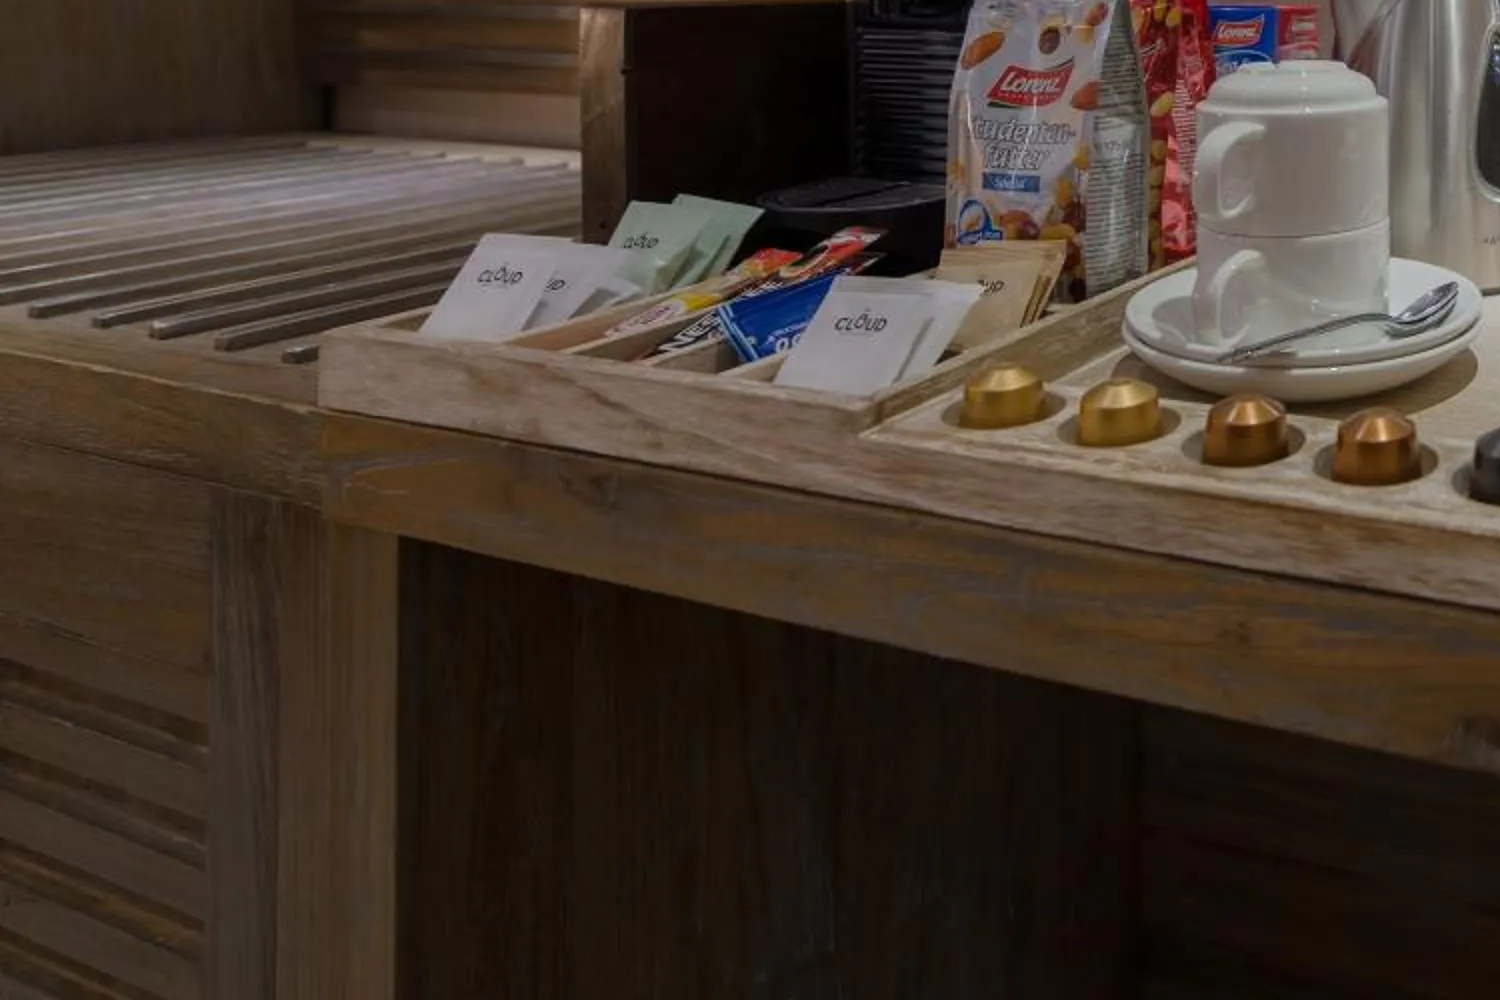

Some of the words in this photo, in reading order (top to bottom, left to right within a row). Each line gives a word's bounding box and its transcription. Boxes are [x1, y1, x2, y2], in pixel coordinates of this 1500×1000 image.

[1001, 71, 1062, 94] Lorenz
[477, 265, 524, 285] CLOUD
[834, 312, 888, 333] CLOUD
